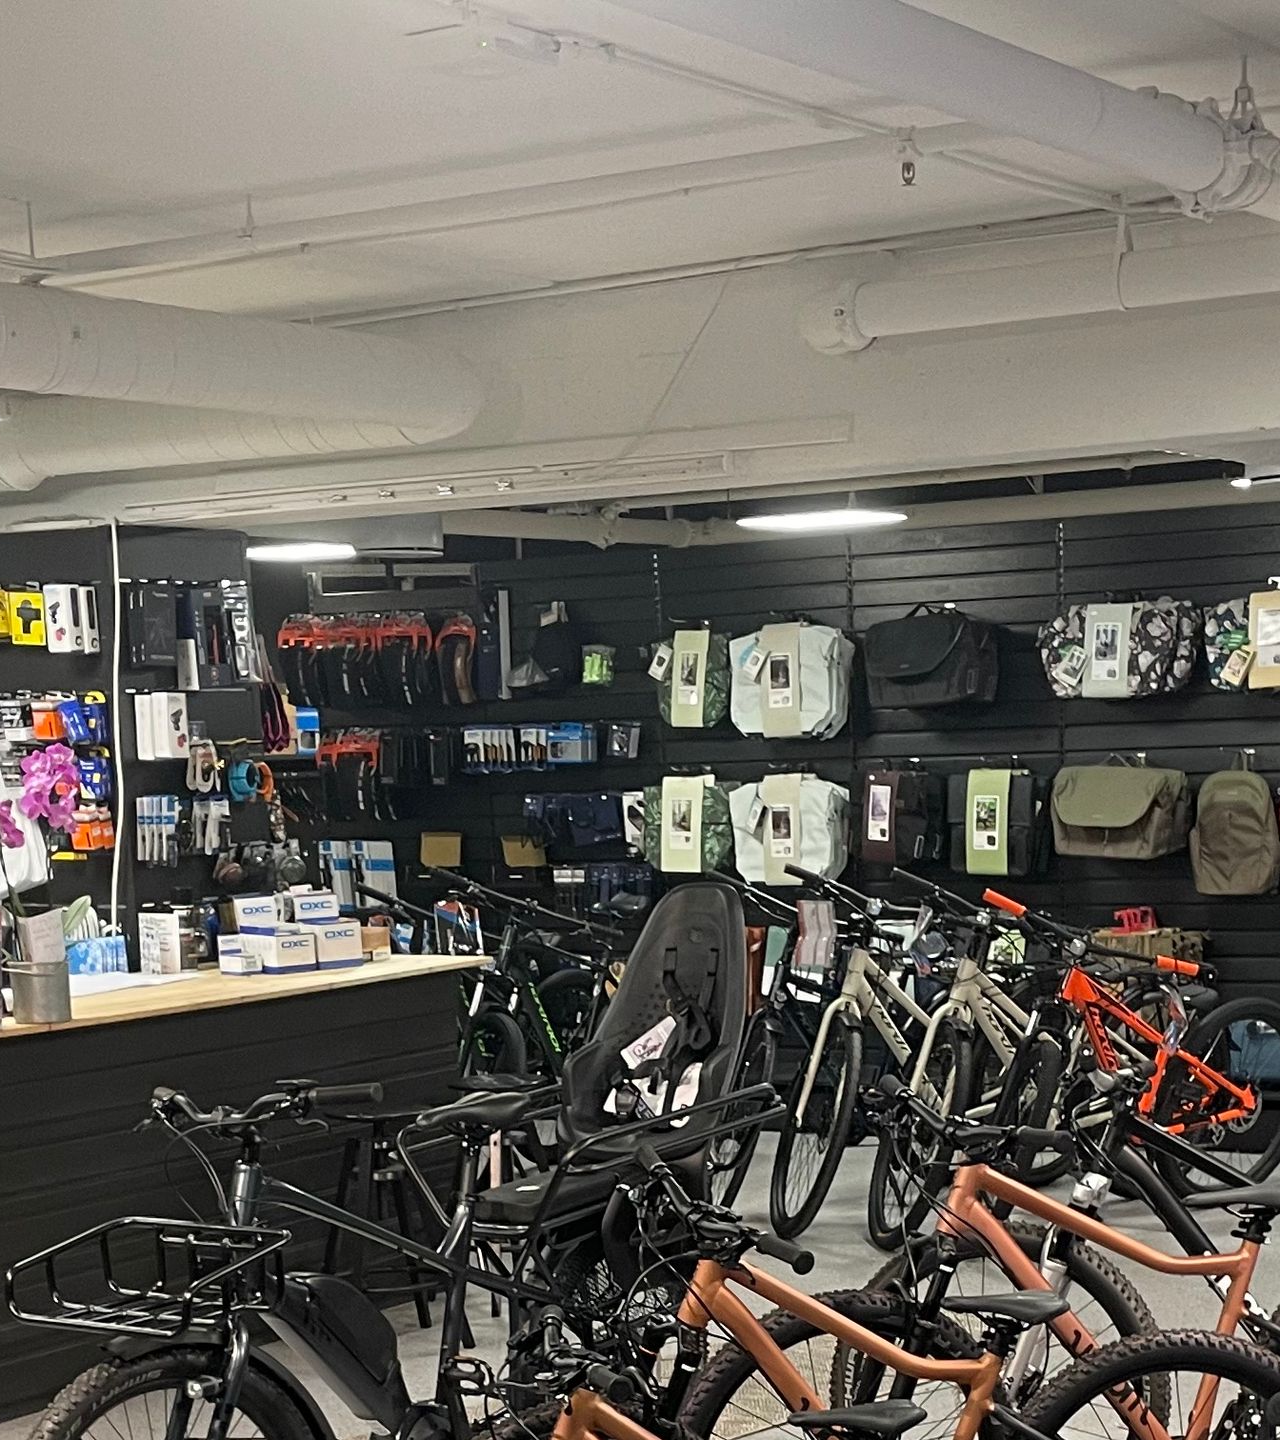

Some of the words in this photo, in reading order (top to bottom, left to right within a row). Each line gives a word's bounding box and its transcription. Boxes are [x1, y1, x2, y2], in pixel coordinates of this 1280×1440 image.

[242, 905, 272, 915] OXC
[300, 901, 332, 911] OXC
[325, 929, 355, 939] OXC
[281, 940, 309, 949] OXC
